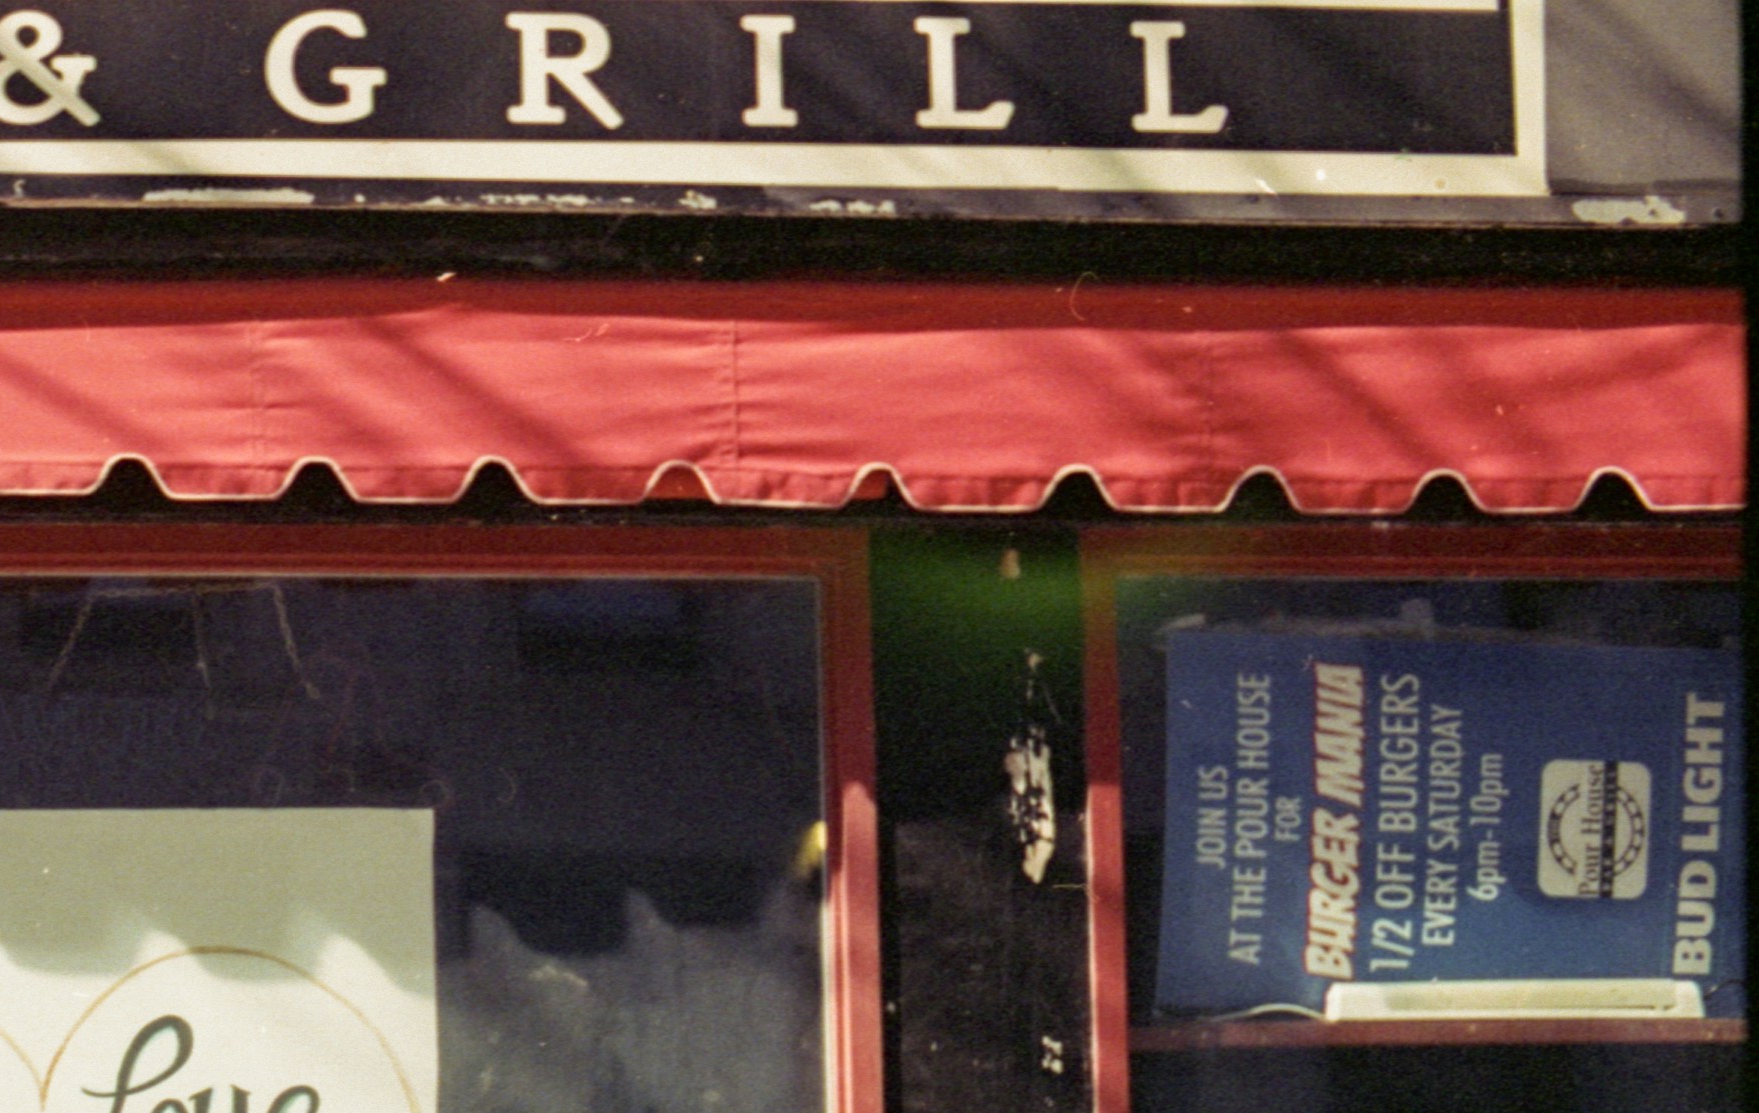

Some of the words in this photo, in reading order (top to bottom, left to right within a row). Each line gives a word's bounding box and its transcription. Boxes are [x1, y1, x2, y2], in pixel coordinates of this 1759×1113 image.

[263, 8, 1230, 134] GRILL
[1236, 673, 1272, 769] HOUSE
[1312, 660, 1365, 807] MANIA
[1379, 673, 1420, 832] BURGERS
[1198, 765, 1228, 800] US
[1427, 702, 1463, 850] SATURDAY
[1580, 764, 1604, 835] House
[1680, 691, 1726, 851] LIGHT
[1196, 807, 1227, 869] JOIN
[1234, 778, 1270, 857] POUR
[1275, 796, 1302, 841] FOR
[1468, 752, 1507, 901] 6pm-10pm
[1230, 868, 1267, 920] THE
[1304, 807, 1360, 980] BURGER
[1376, 842, 1416, 908] OFF
[1423, 857, 1458, 946] EVERY
[1577, 844, 1600, 896] Pour
[1229, 931, 1261, 965] AT
[1370, 918, 1414, 973] 1/2
[1671, 859, 1716, 975] BUD
